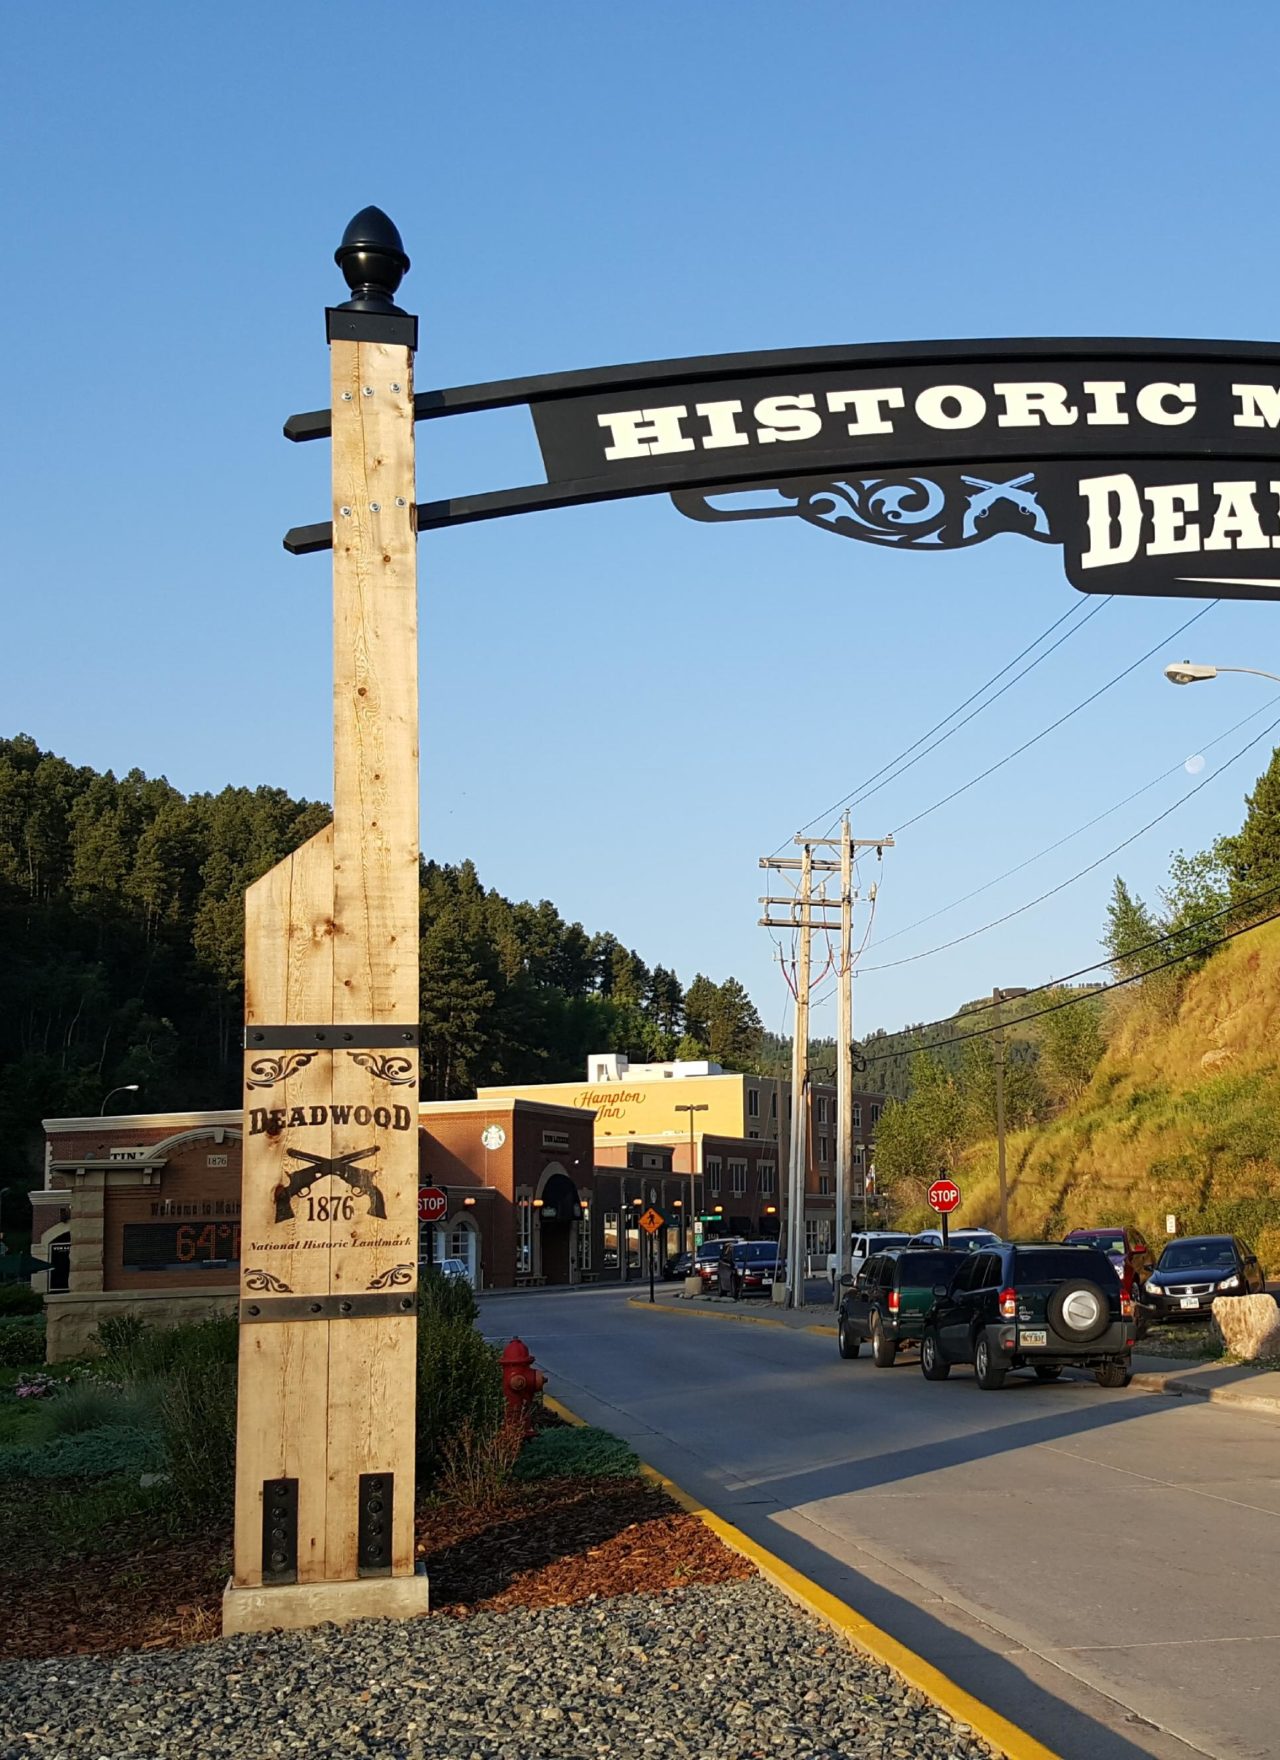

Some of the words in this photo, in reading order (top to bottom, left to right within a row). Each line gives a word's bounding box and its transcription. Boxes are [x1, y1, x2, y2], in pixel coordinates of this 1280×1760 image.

[598, 382, 1196, 460] HISTORIC
[574, 1090, 646, 1108] Hampton
[249, 1104, 411, 1135] DEADWOOD
[594, 1105, 626, 1122] Inn
[111, 1152, 136, 1160] TIN
[207, 1156, 227, 1167] 1876
[418, 1197, 445, 1211] STOP
[931, 1190, 957, 1203] STOP
[151, 1202, 197, 1216] Welcome
[202, 1201, 212, 1215] to
[307, 1196, 354, 1221] 1876
[249, 1240, 299, 1250] National
[302, 1239, 349, 1249] Historic
[352, 1237, 412, 1248] Landmark
